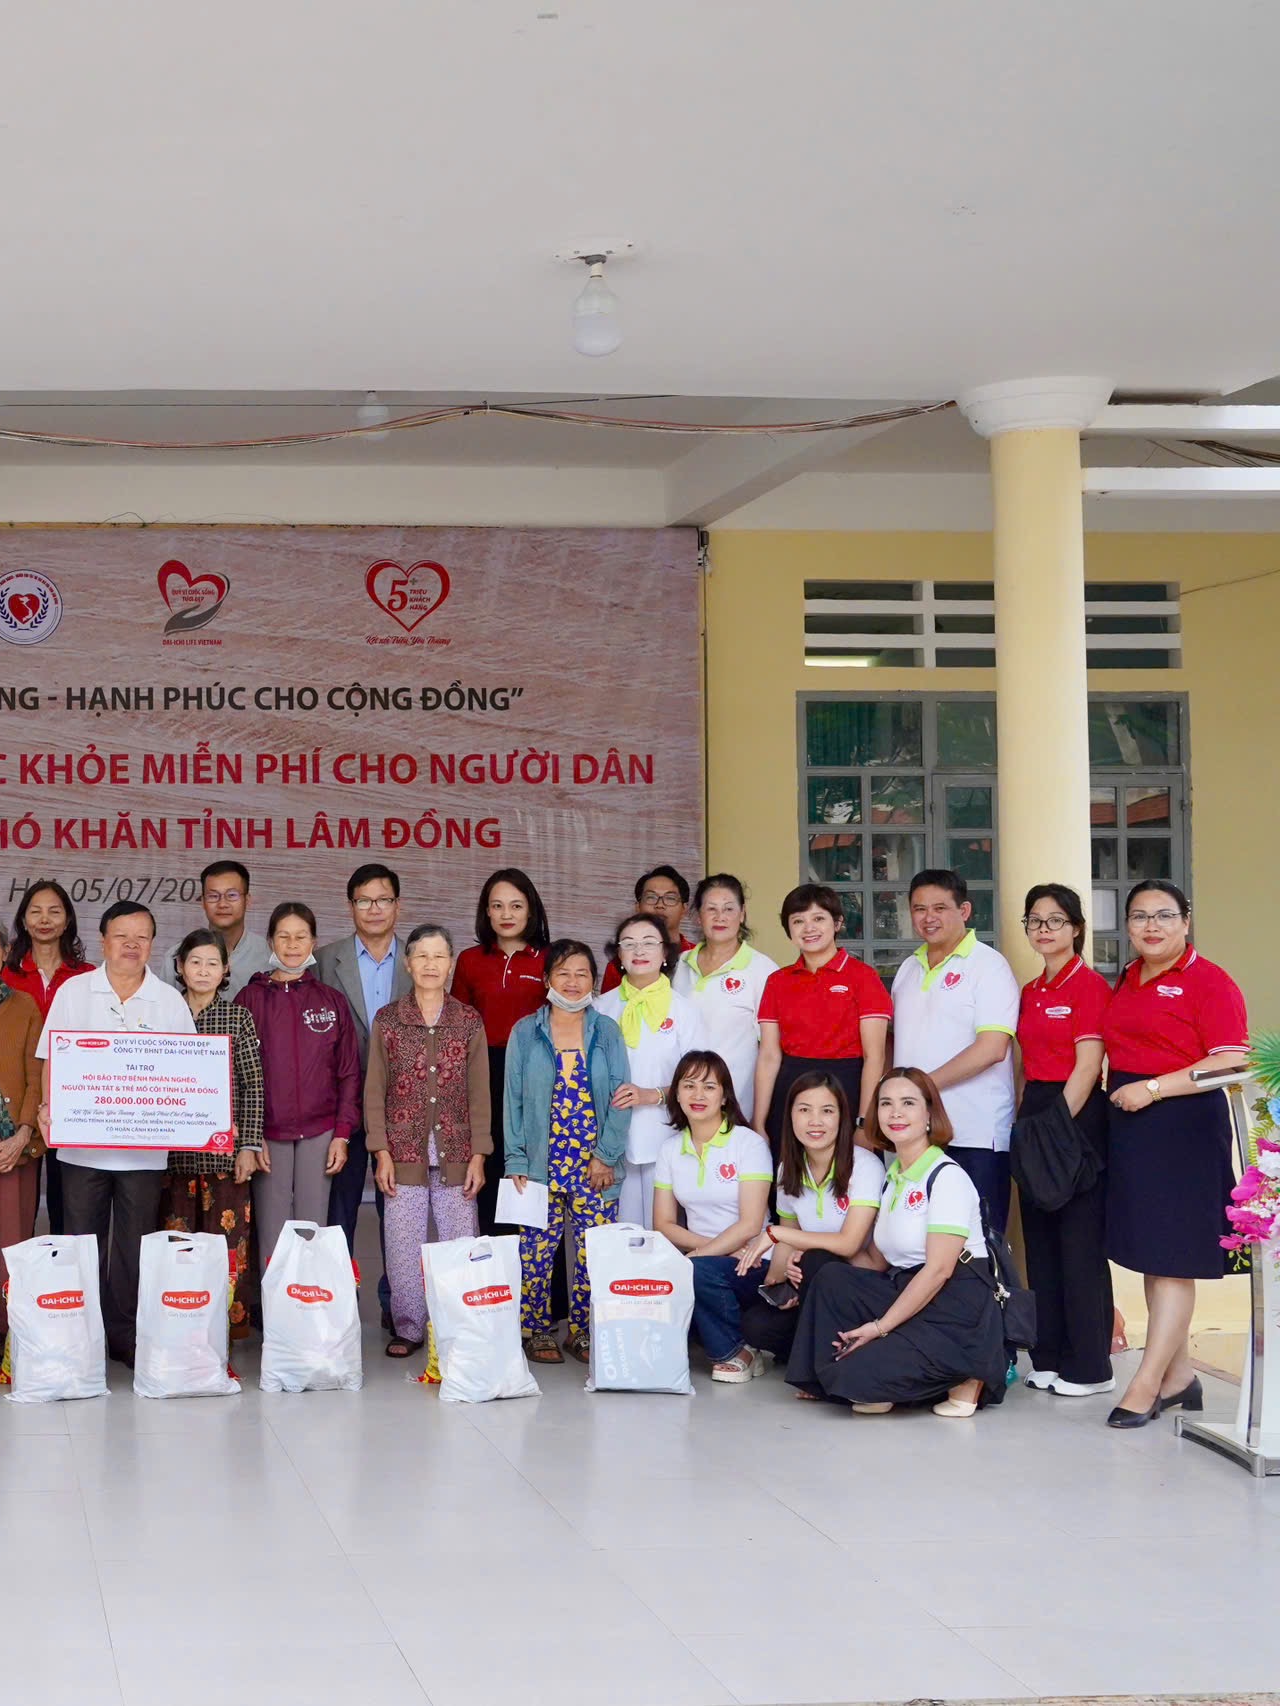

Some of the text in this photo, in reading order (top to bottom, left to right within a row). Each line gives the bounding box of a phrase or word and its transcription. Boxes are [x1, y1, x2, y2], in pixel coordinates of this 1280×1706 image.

[66, 687, 153, 717] HẠNH
[164, 681, 246, 711] PHÚC
[254, 687, 319, 711] CHO
[327, 682, 412, 717] CỘNG
[21, 744, 129, 785] KHỎE
[142, 741, 242, 785] MIỄN
[256, 746, 323, 784] PHÍ
[332, 753, 418, 785] CHO
[430, 747, 560, 785] NGƯỜI
[573, 747, 653, 785] DÂN
[54, 811, 167, 850] KHĂN
[177, 807, 273, 849] TỈNH
[286, 810, 370, 849] LÂM
[381, 808, 501, 849] ĐỒNG
[71, 877, 203, 904] 05/07/20
[303, 1008, 337, 1024] Smile
[94, 1096, 154, 1105] 280.000.000
[614, 1283, 670, 1291] DAI-ICHI LIFE
[41, 1296, 75, 1305] DAI-ICHI
[466, 1289, 512, 1302] DAI-ICHI LIF
